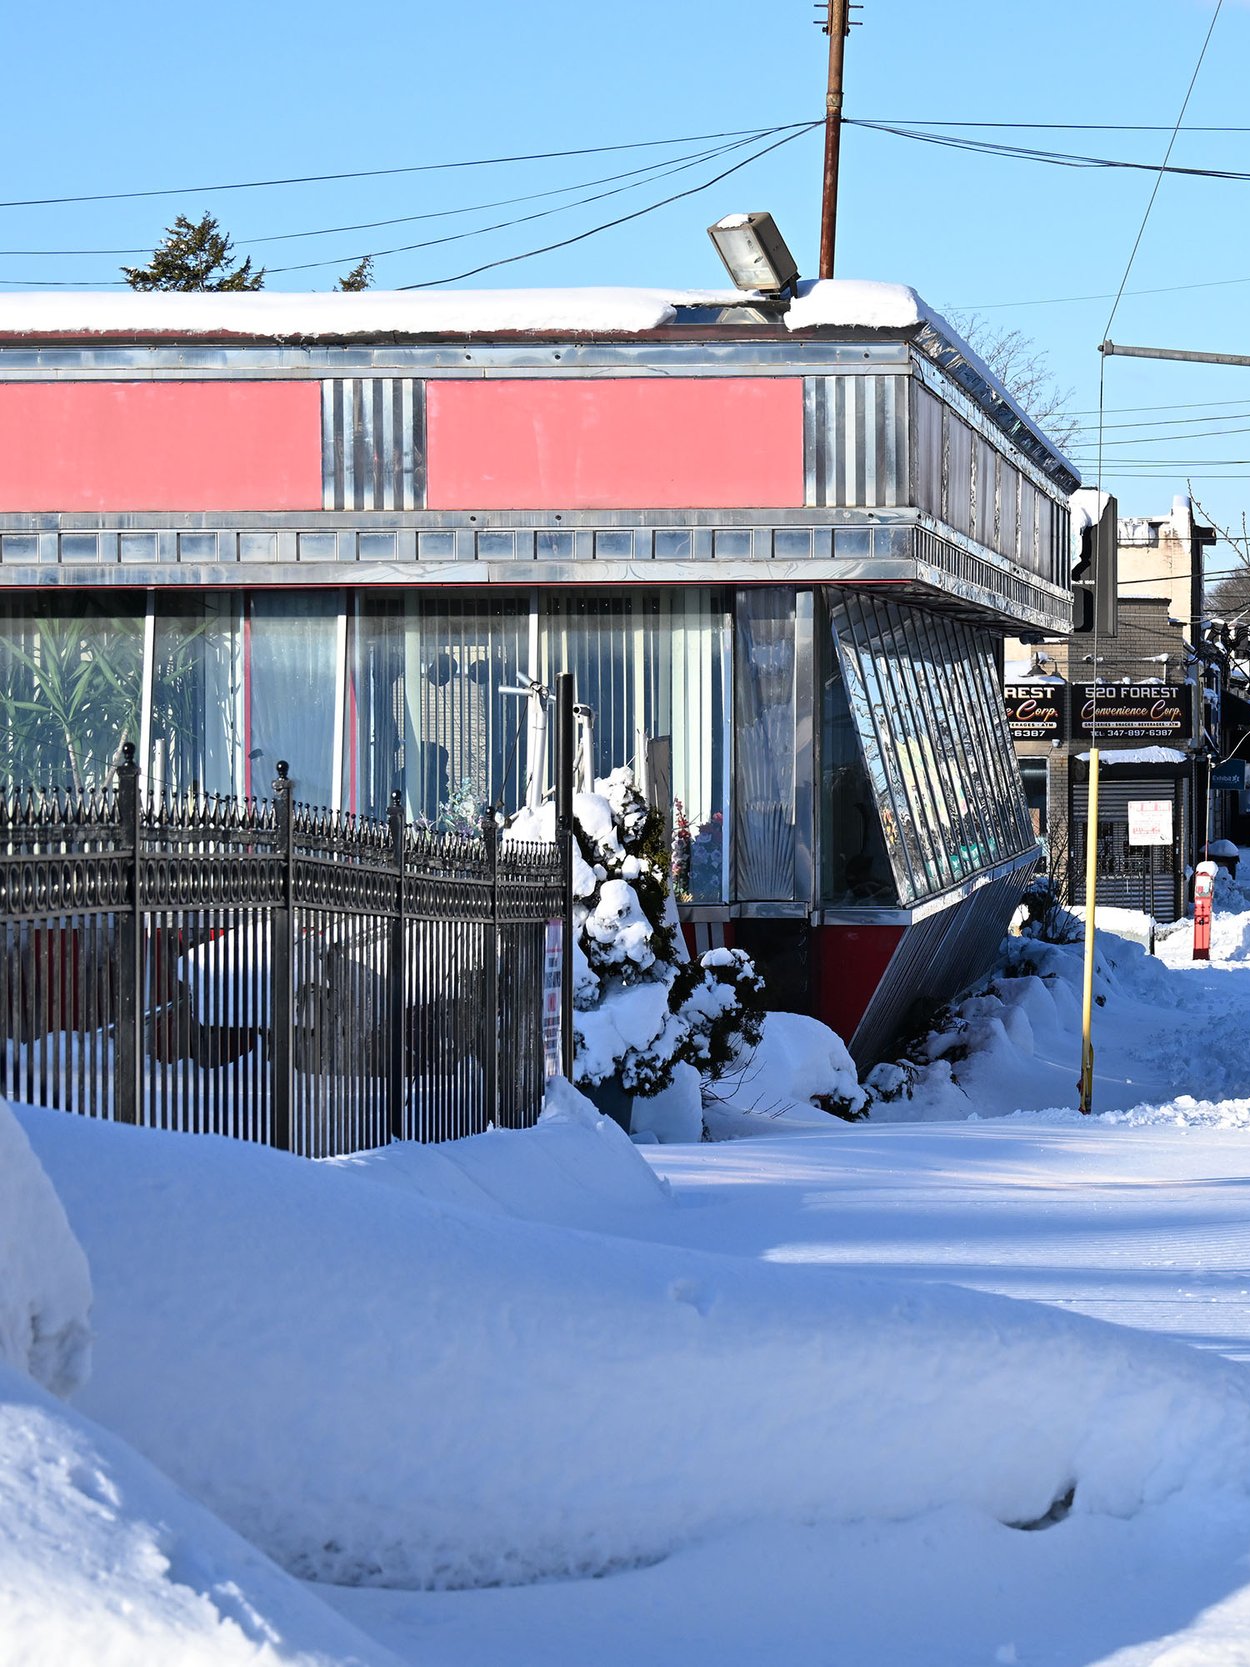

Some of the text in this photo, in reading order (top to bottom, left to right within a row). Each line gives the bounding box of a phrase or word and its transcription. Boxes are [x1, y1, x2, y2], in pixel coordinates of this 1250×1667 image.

[1005, 687, 1055, 698] REST
[1085, 687, 1179, 698] 520 FOREST
[1016, 700, 1058, 721] Corp.
[1081, 699, 1182, 721] Convenience Corp.
